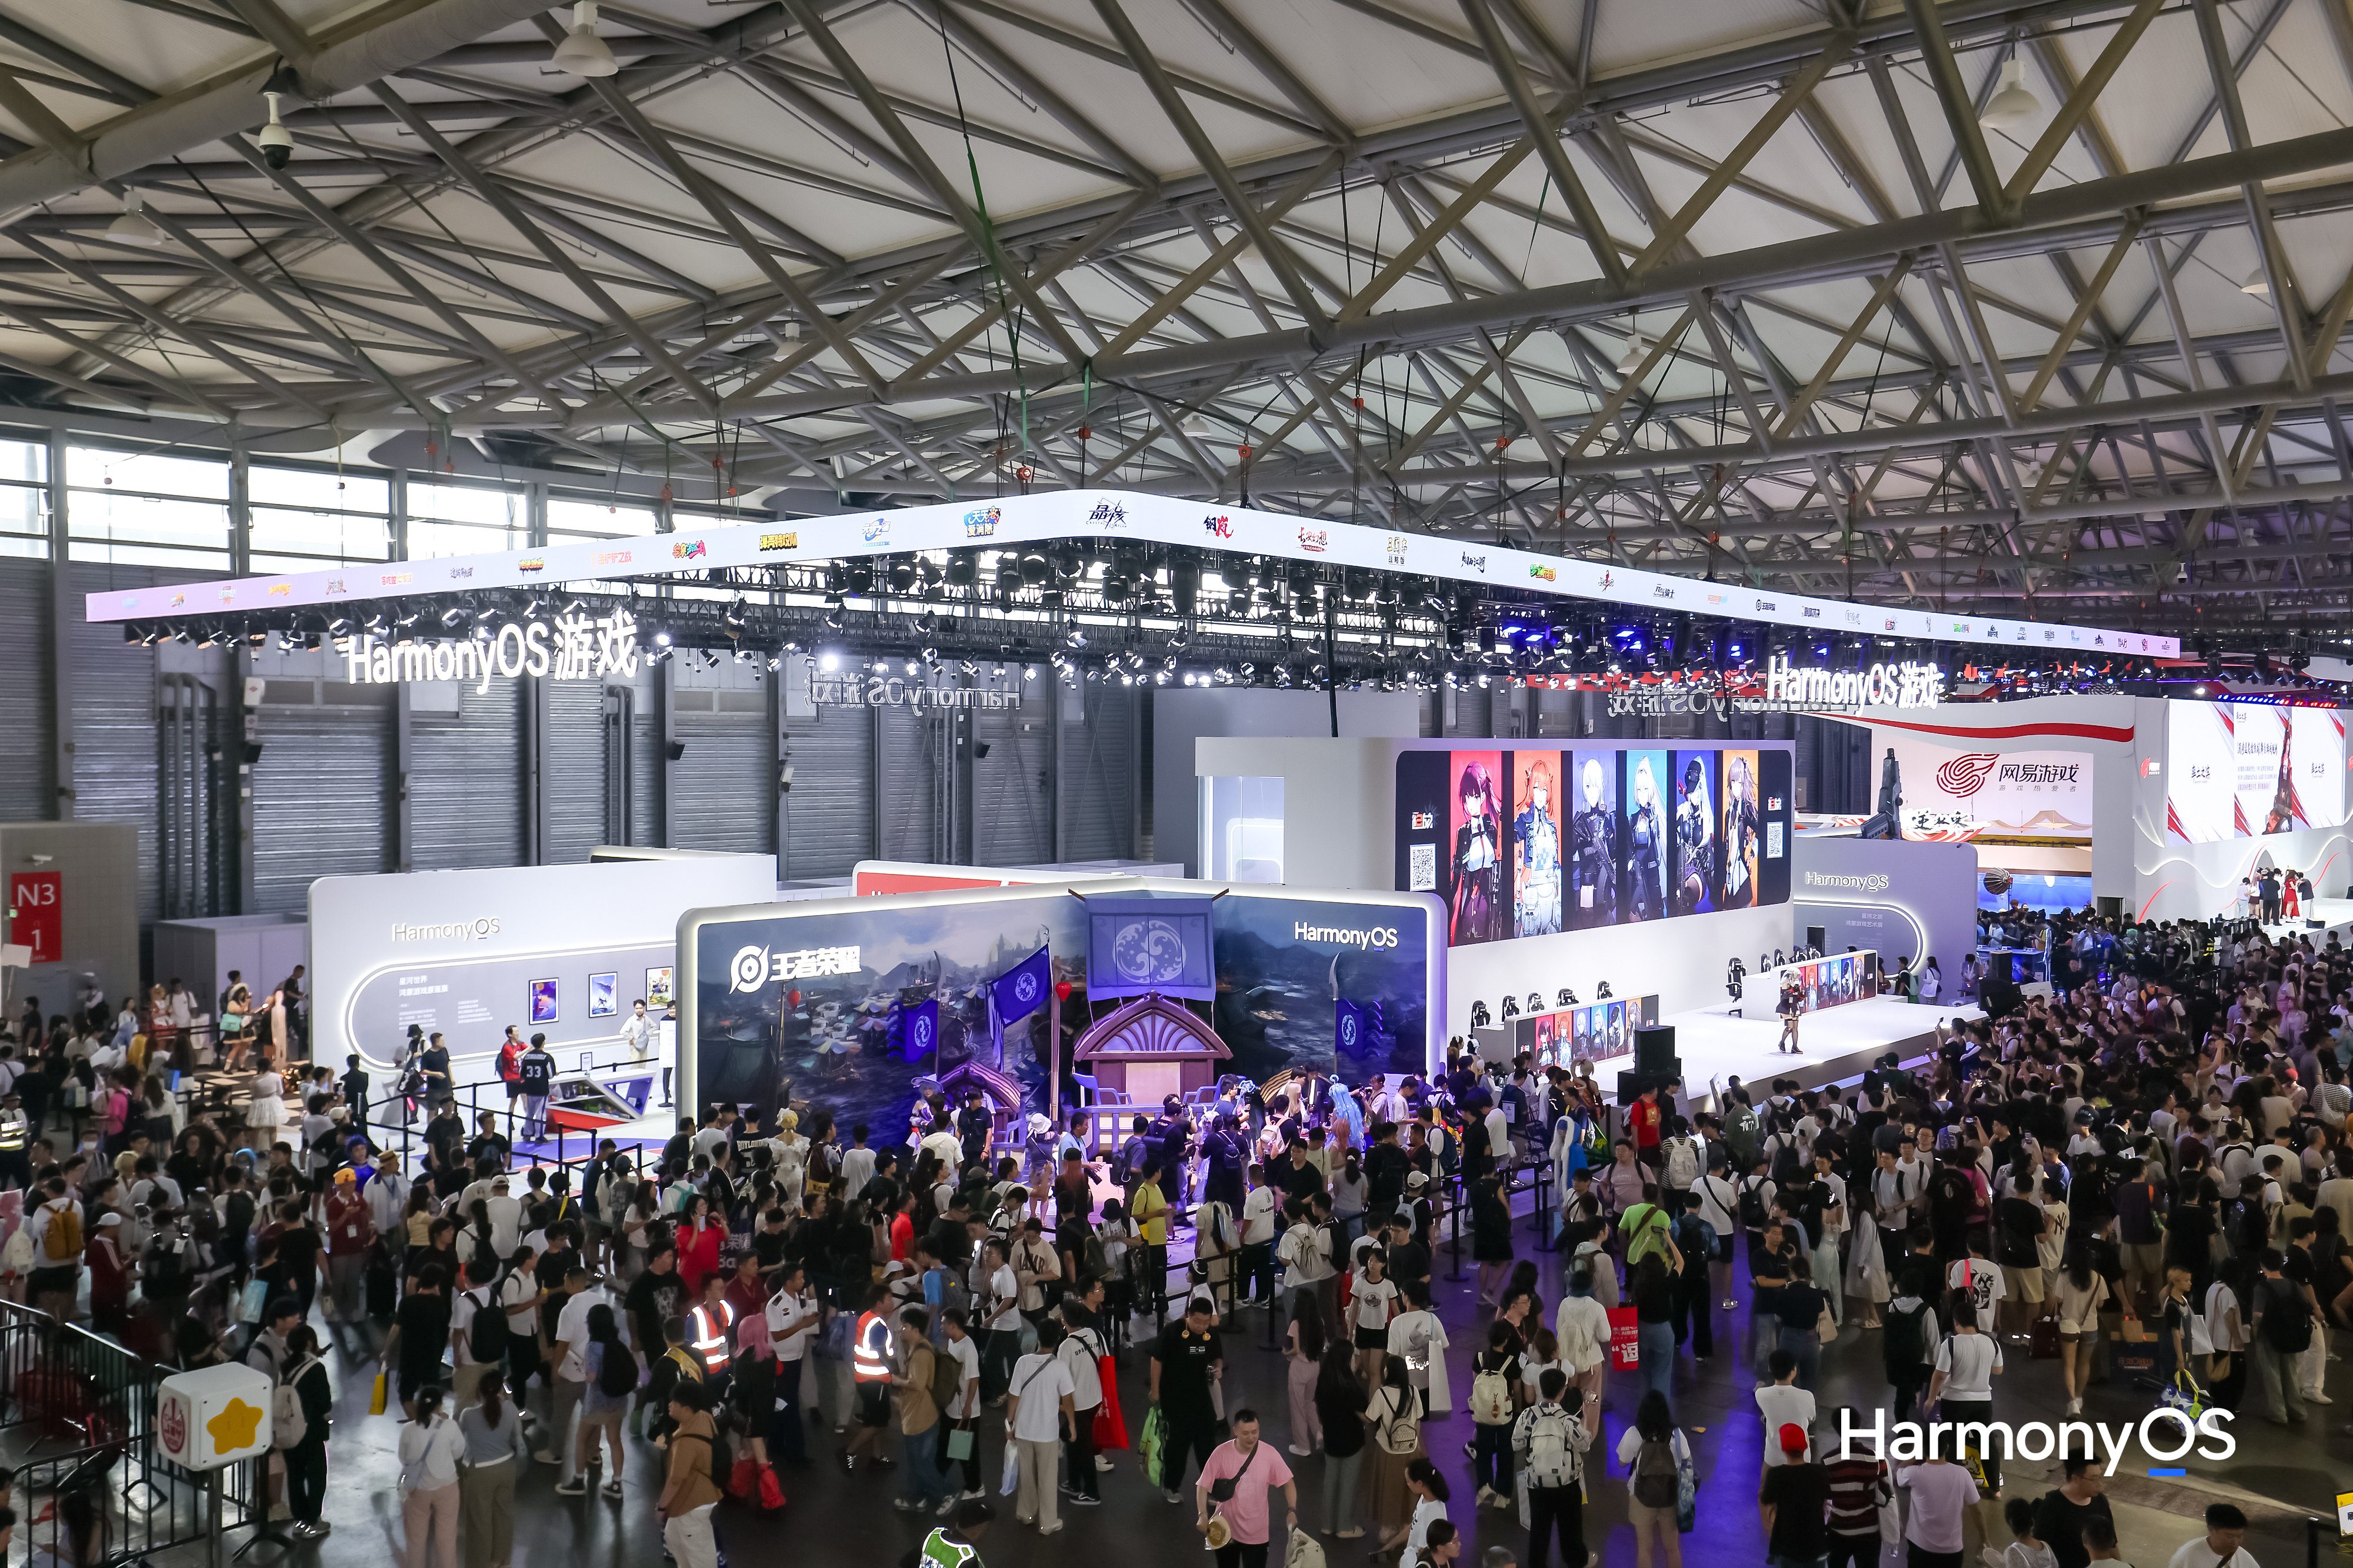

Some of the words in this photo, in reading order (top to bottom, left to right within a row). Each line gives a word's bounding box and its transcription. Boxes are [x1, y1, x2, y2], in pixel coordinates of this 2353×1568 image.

[759, 532, 798, 551] 弹壳特攻队
[1298, 527, 1328, 546] 长安幻想
[1530, 563, 1554, 579] 梦幻花园
[1999, 763, 2079, 783] 网易游戏
[1805, 872, 1888, 890] HarmonyOS
[18, 883, 55, 907] N3
[31, 929, 41, 950] 1
[392, 918, 500, 942] HarmonyOS
[1294, 921, 1398, 950] HarmonyOS
[768, 946, 862, 982] 王者荣耀
[526, 1065, 541, 1077] 33
